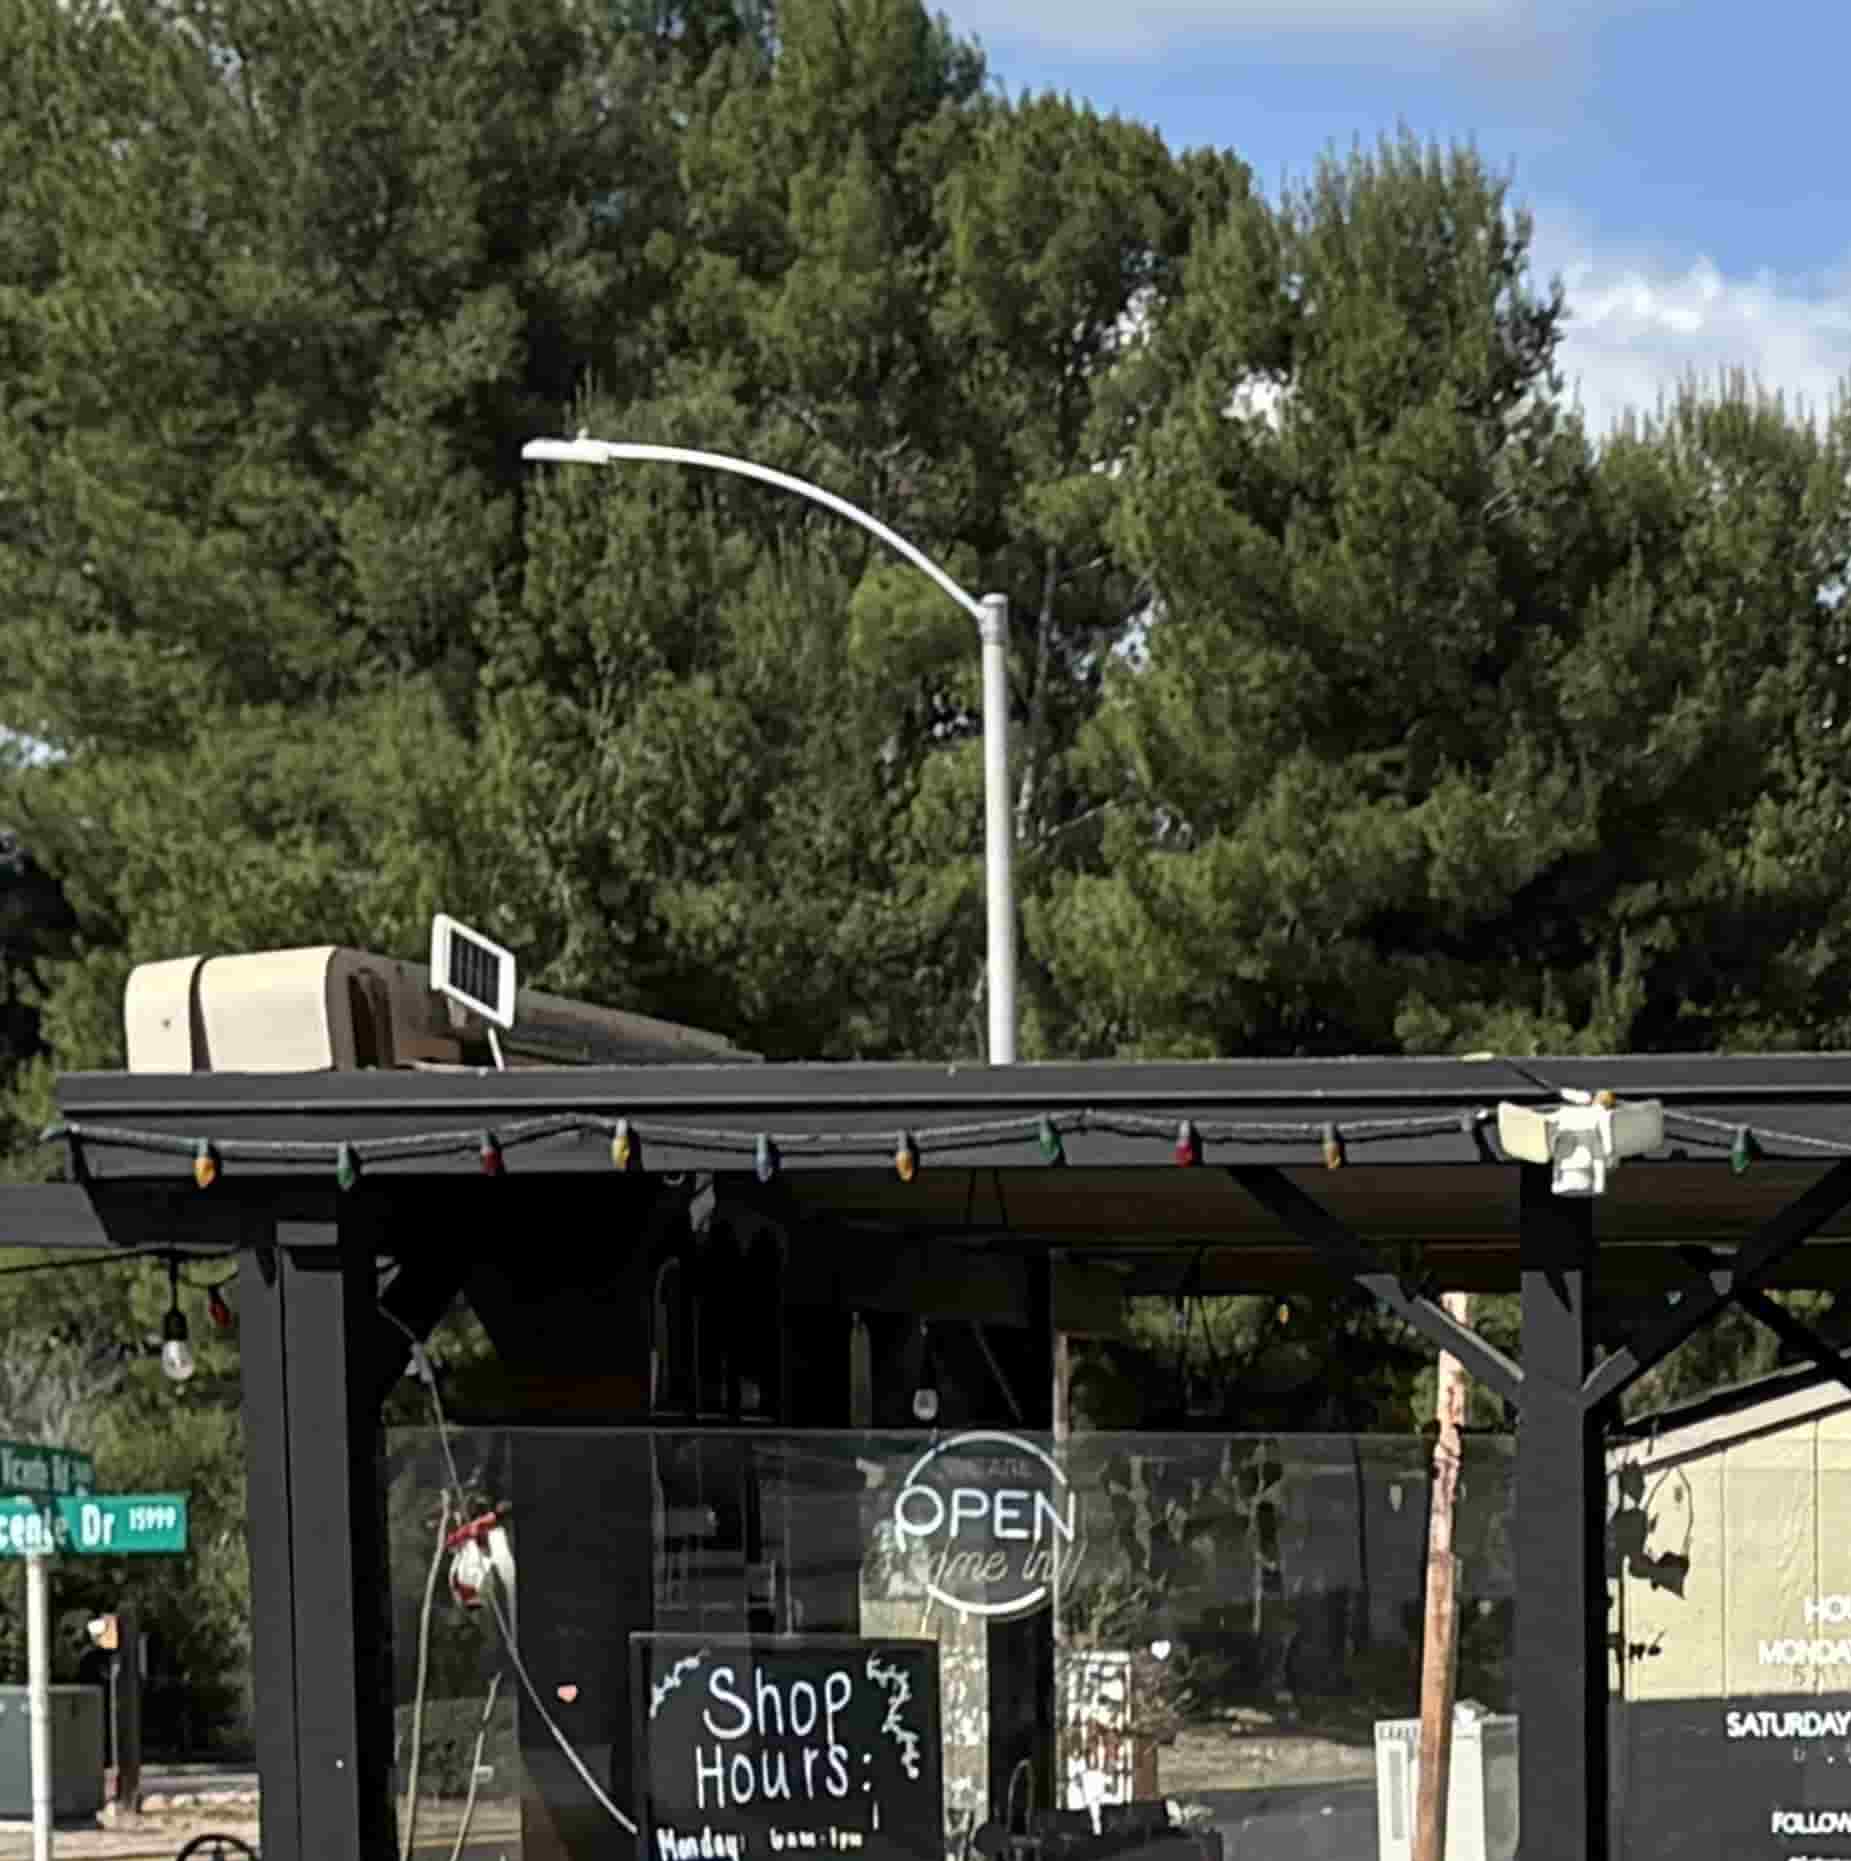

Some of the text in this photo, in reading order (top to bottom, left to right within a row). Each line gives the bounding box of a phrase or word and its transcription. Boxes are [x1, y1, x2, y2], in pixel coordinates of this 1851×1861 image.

[81, 1503, 115, 1546] Dr
[894, 1484, 1075, 1544] OPEN
[702, 1666, 851, 1748] Shop
[1726, 1710, 1851, 1737] SATURDAY
[695, 1743, 872, 1808] Hours:
